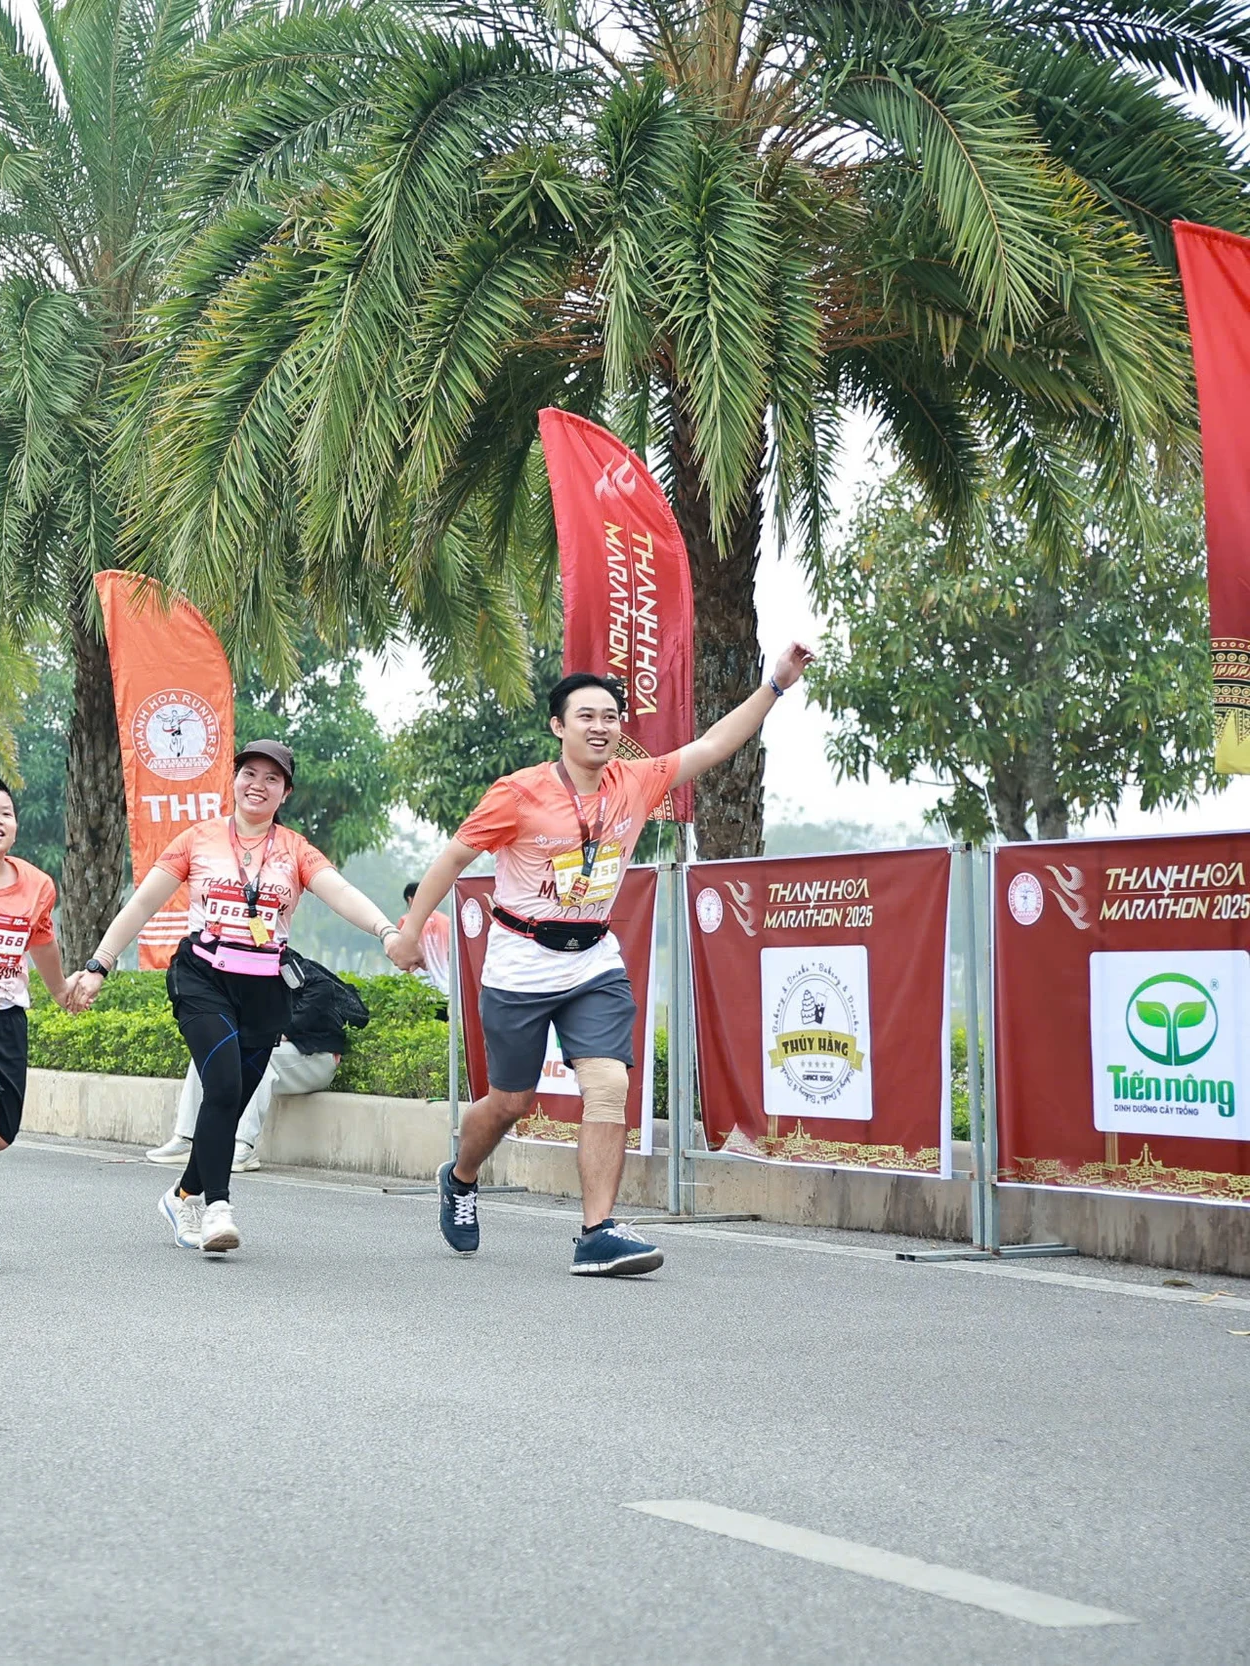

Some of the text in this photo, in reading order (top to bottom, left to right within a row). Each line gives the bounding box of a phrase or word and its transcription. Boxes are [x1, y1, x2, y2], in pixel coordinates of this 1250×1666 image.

[603, 520, 629, 670] MARATHON
[632, 531, 658, 646] THANH
[135, 692, 217, 760] THANH HOA RUNNERS
[141, 793, 222, 823] THR
[1105, 864, 1191, 890] THANH
[768, 881, 829, 904] THANH
[763, 905, 873, 929] MARATHON 2025
[1099, 894, 1250, 921] MARATHON 2025
[781, 1032, 849, 1057] THÚY HẰNG
[1106, 1064, 1236, 1118] Tiến nông
[1114, 1104, 1131, 1113] DINH
